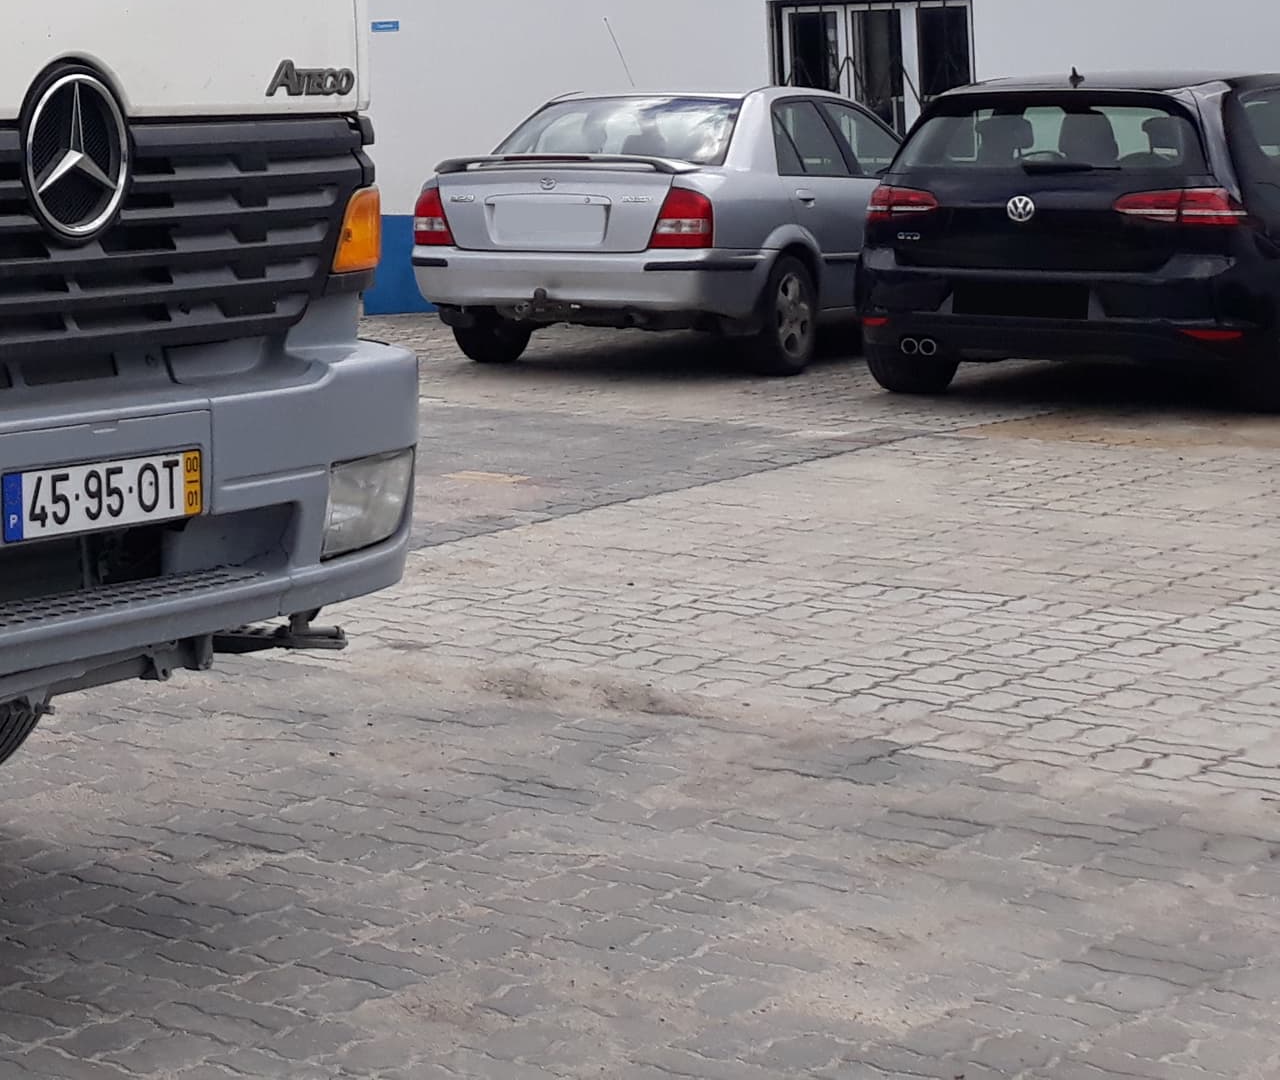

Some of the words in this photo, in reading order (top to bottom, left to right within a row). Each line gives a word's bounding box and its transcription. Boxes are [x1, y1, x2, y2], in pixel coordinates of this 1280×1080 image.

[186, 456, 198, 473] 00
[187, 490, 198, 507] 01
[10, 515, 17, 528] P
